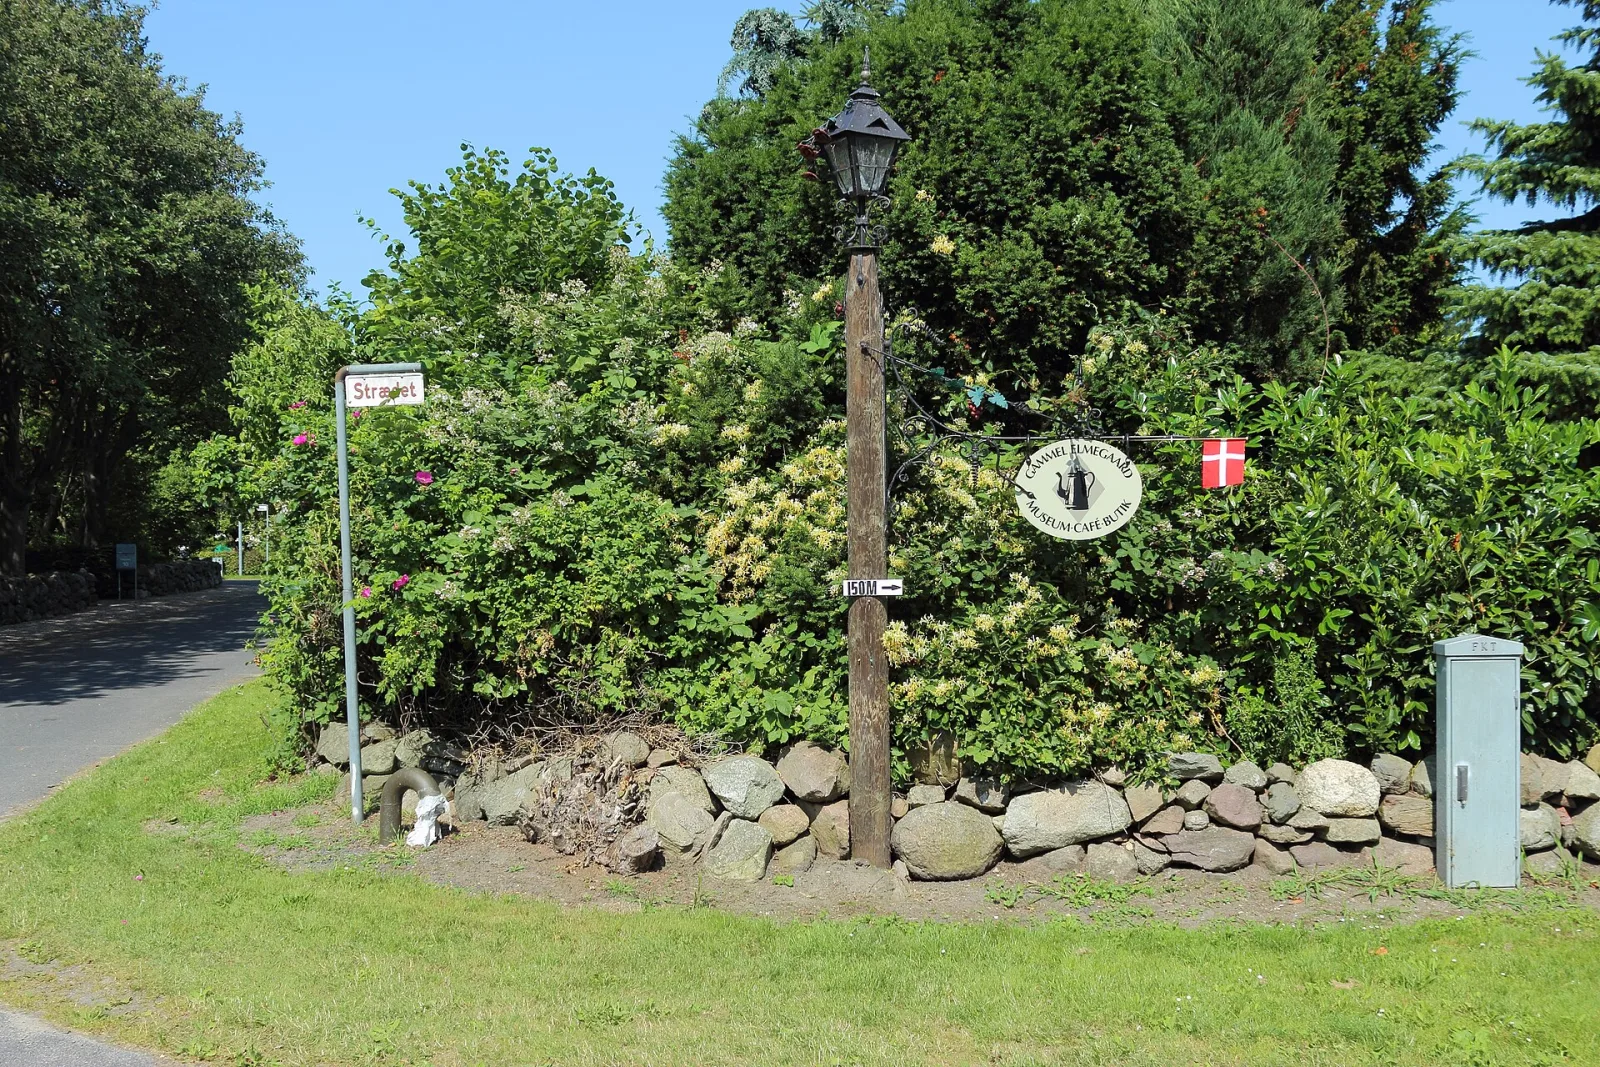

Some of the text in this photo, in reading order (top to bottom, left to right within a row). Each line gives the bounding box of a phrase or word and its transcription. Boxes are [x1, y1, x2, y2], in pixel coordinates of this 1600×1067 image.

[1025, 443, 1133, 479] GAMMEL ELMEGAARD
[1472, 642, 1497, 651] FKT
